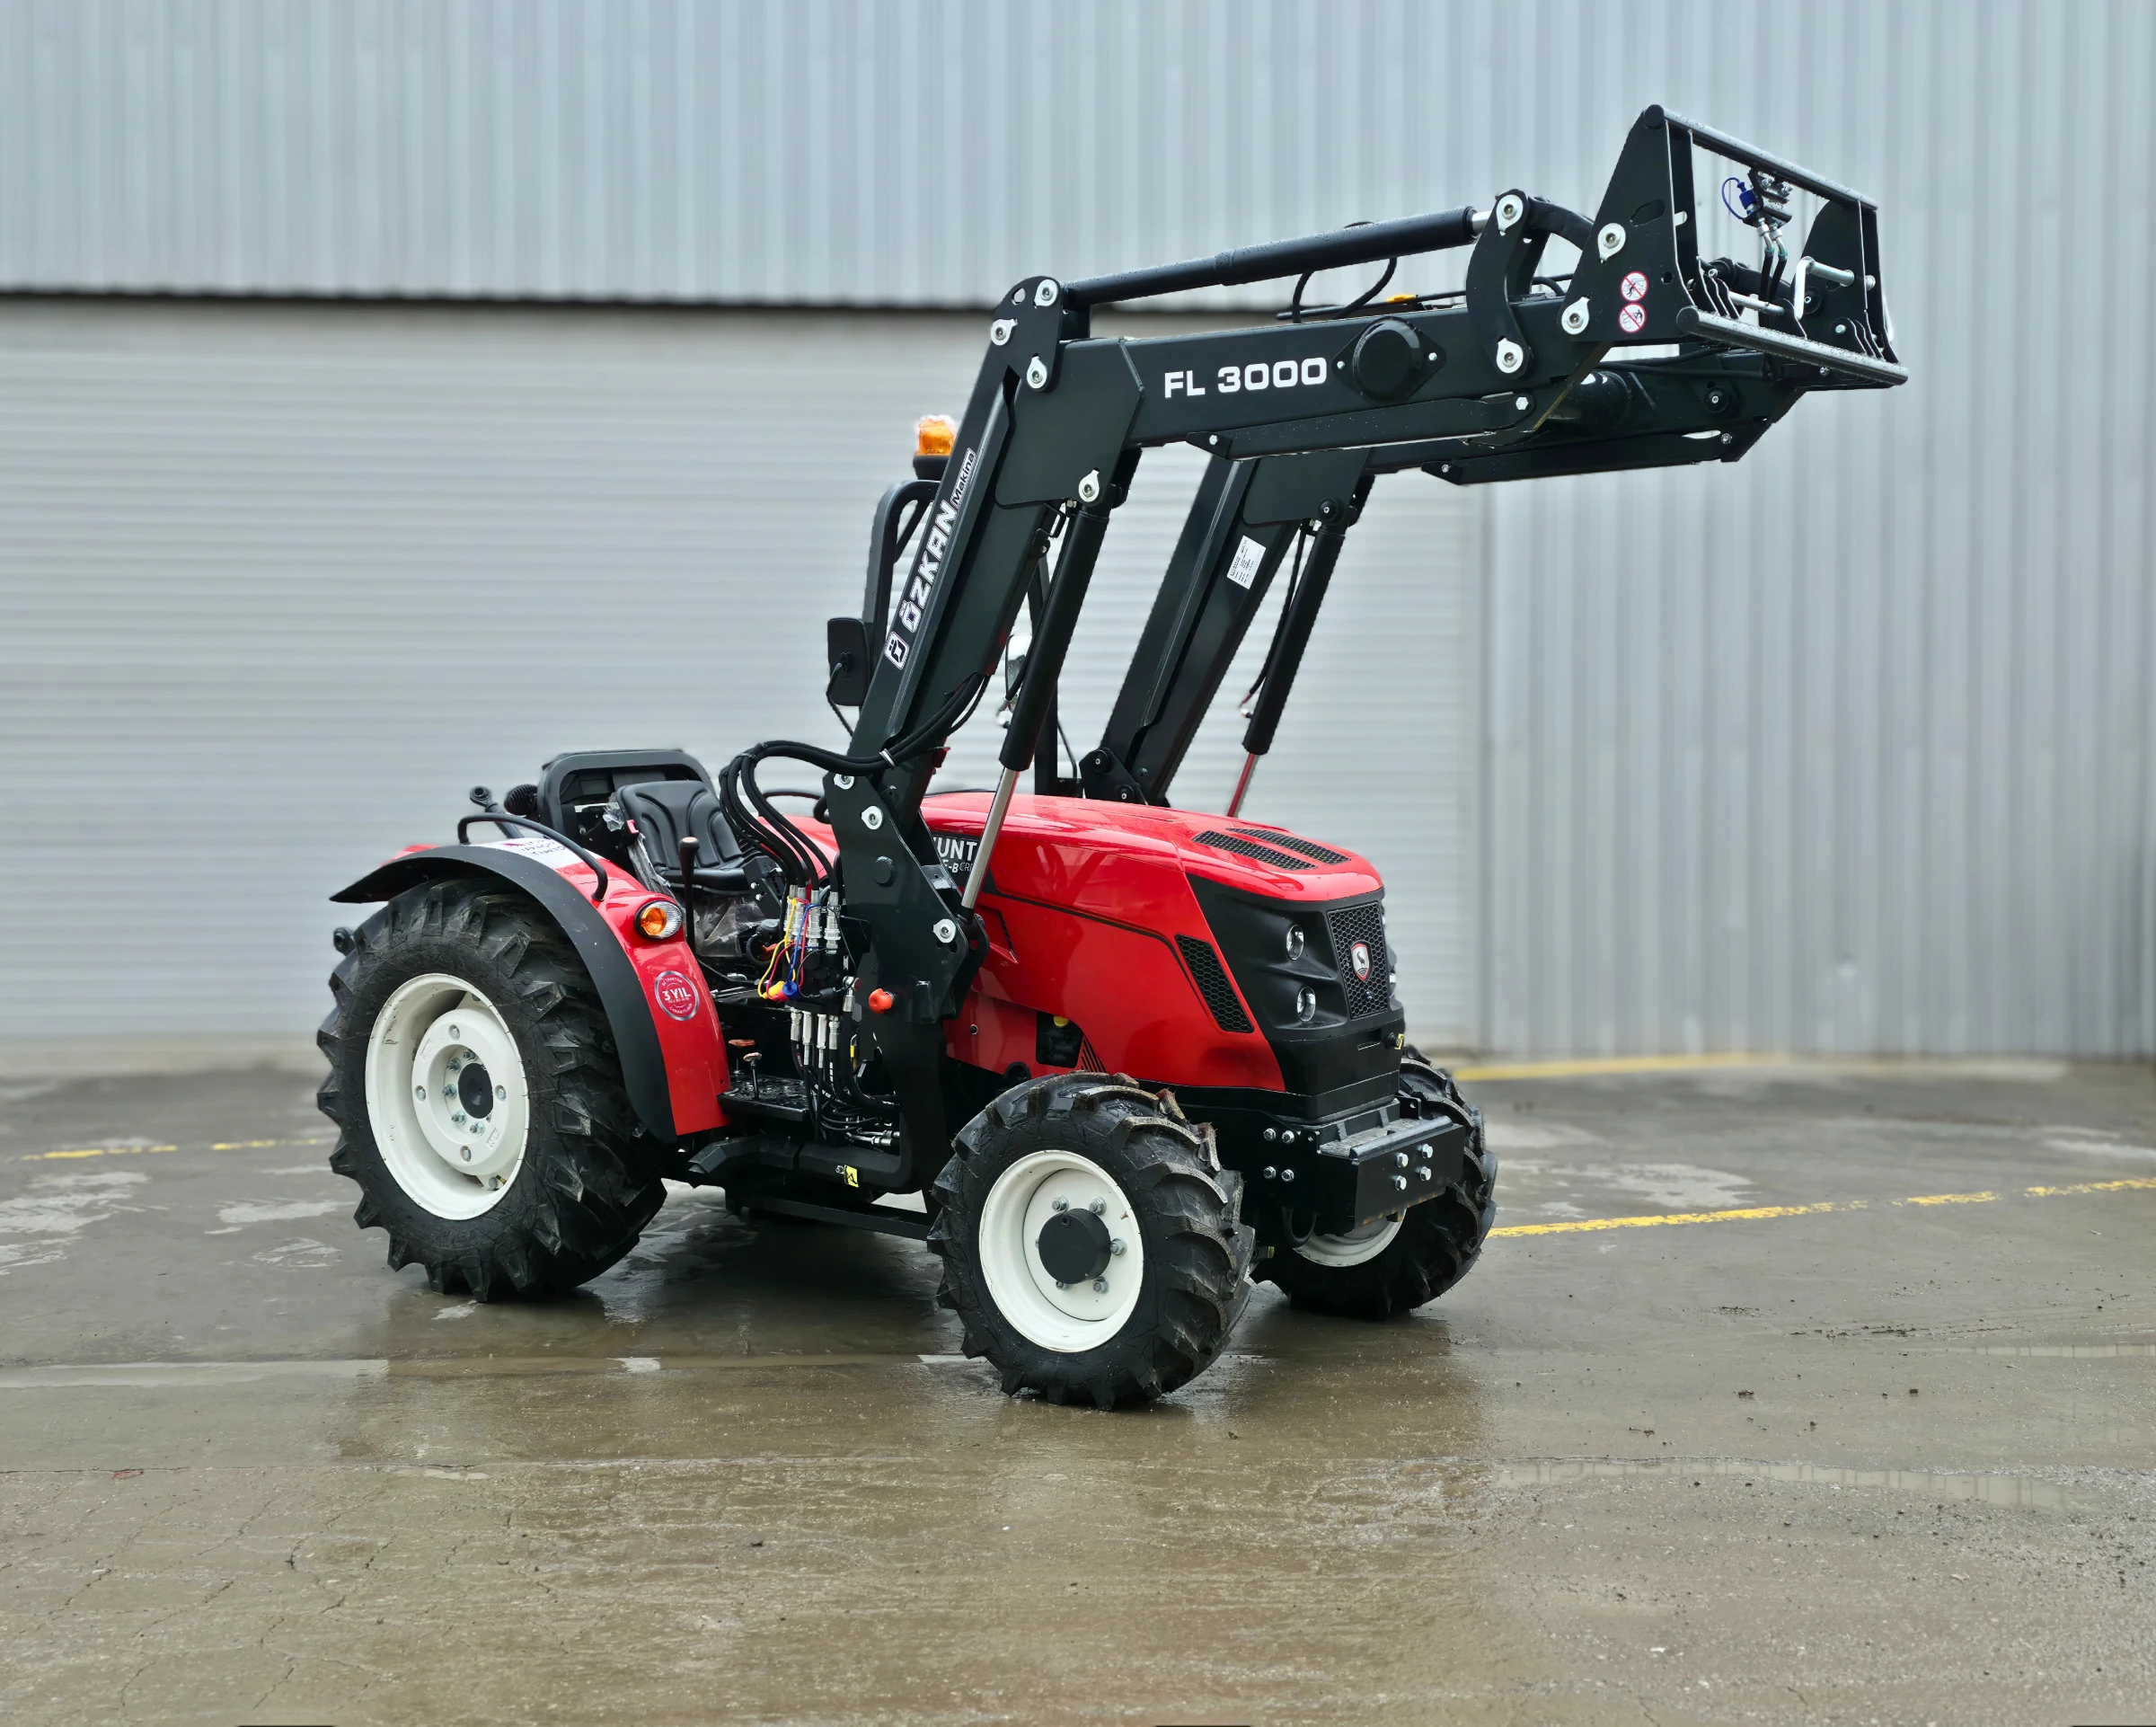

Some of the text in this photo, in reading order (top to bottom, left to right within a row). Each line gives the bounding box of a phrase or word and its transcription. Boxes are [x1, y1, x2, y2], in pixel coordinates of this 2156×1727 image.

[1164, 357, 1327, 398] FL 3000
[899, 500, 959, 633] ÖZKAN
[952, 452, 975, 506] Makina
[932, 837, 978, 862] UNT
[662, 990, 671, 1001] 3
[670, 987, 692, 999] YIL
